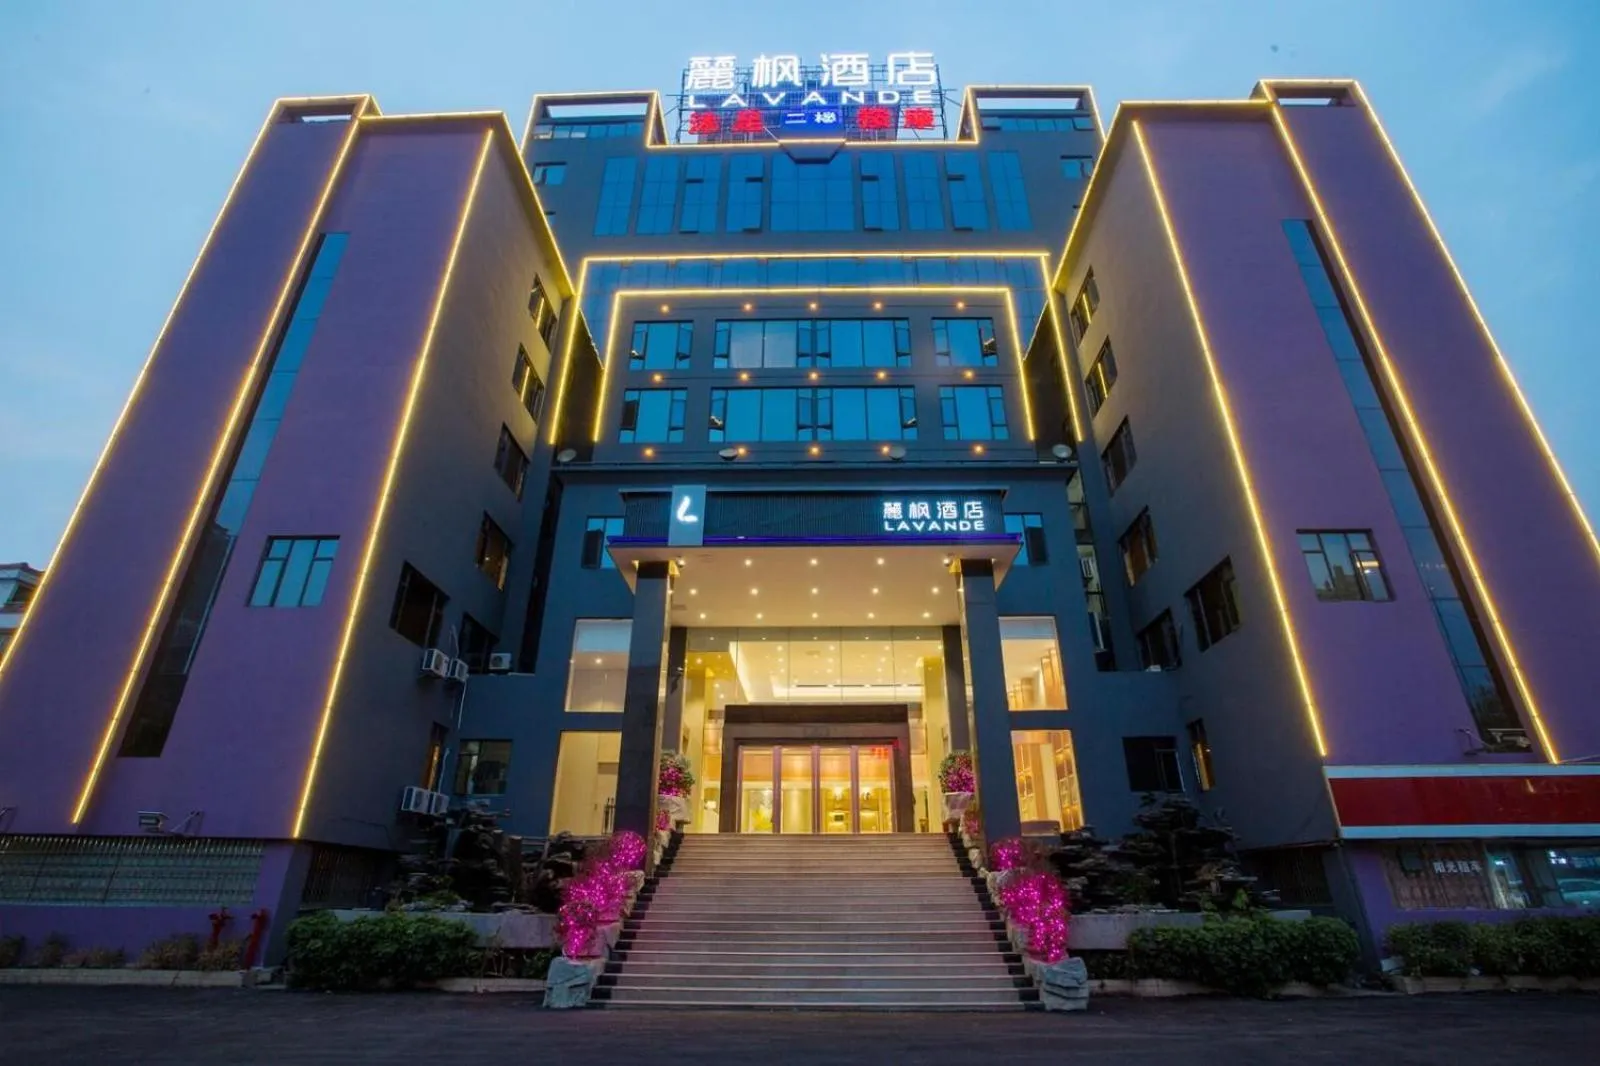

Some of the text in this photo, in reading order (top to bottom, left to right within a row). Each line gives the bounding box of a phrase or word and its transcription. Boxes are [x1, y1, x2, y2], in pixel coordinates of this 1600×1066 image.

[686, 51, 938, 90] 麗枫酒店
[688, 89, 936, 109] LAVANDE
[883, 501, 985, 520] 麗枫酒店
[883, 520, 986, 533] LAVANDE
